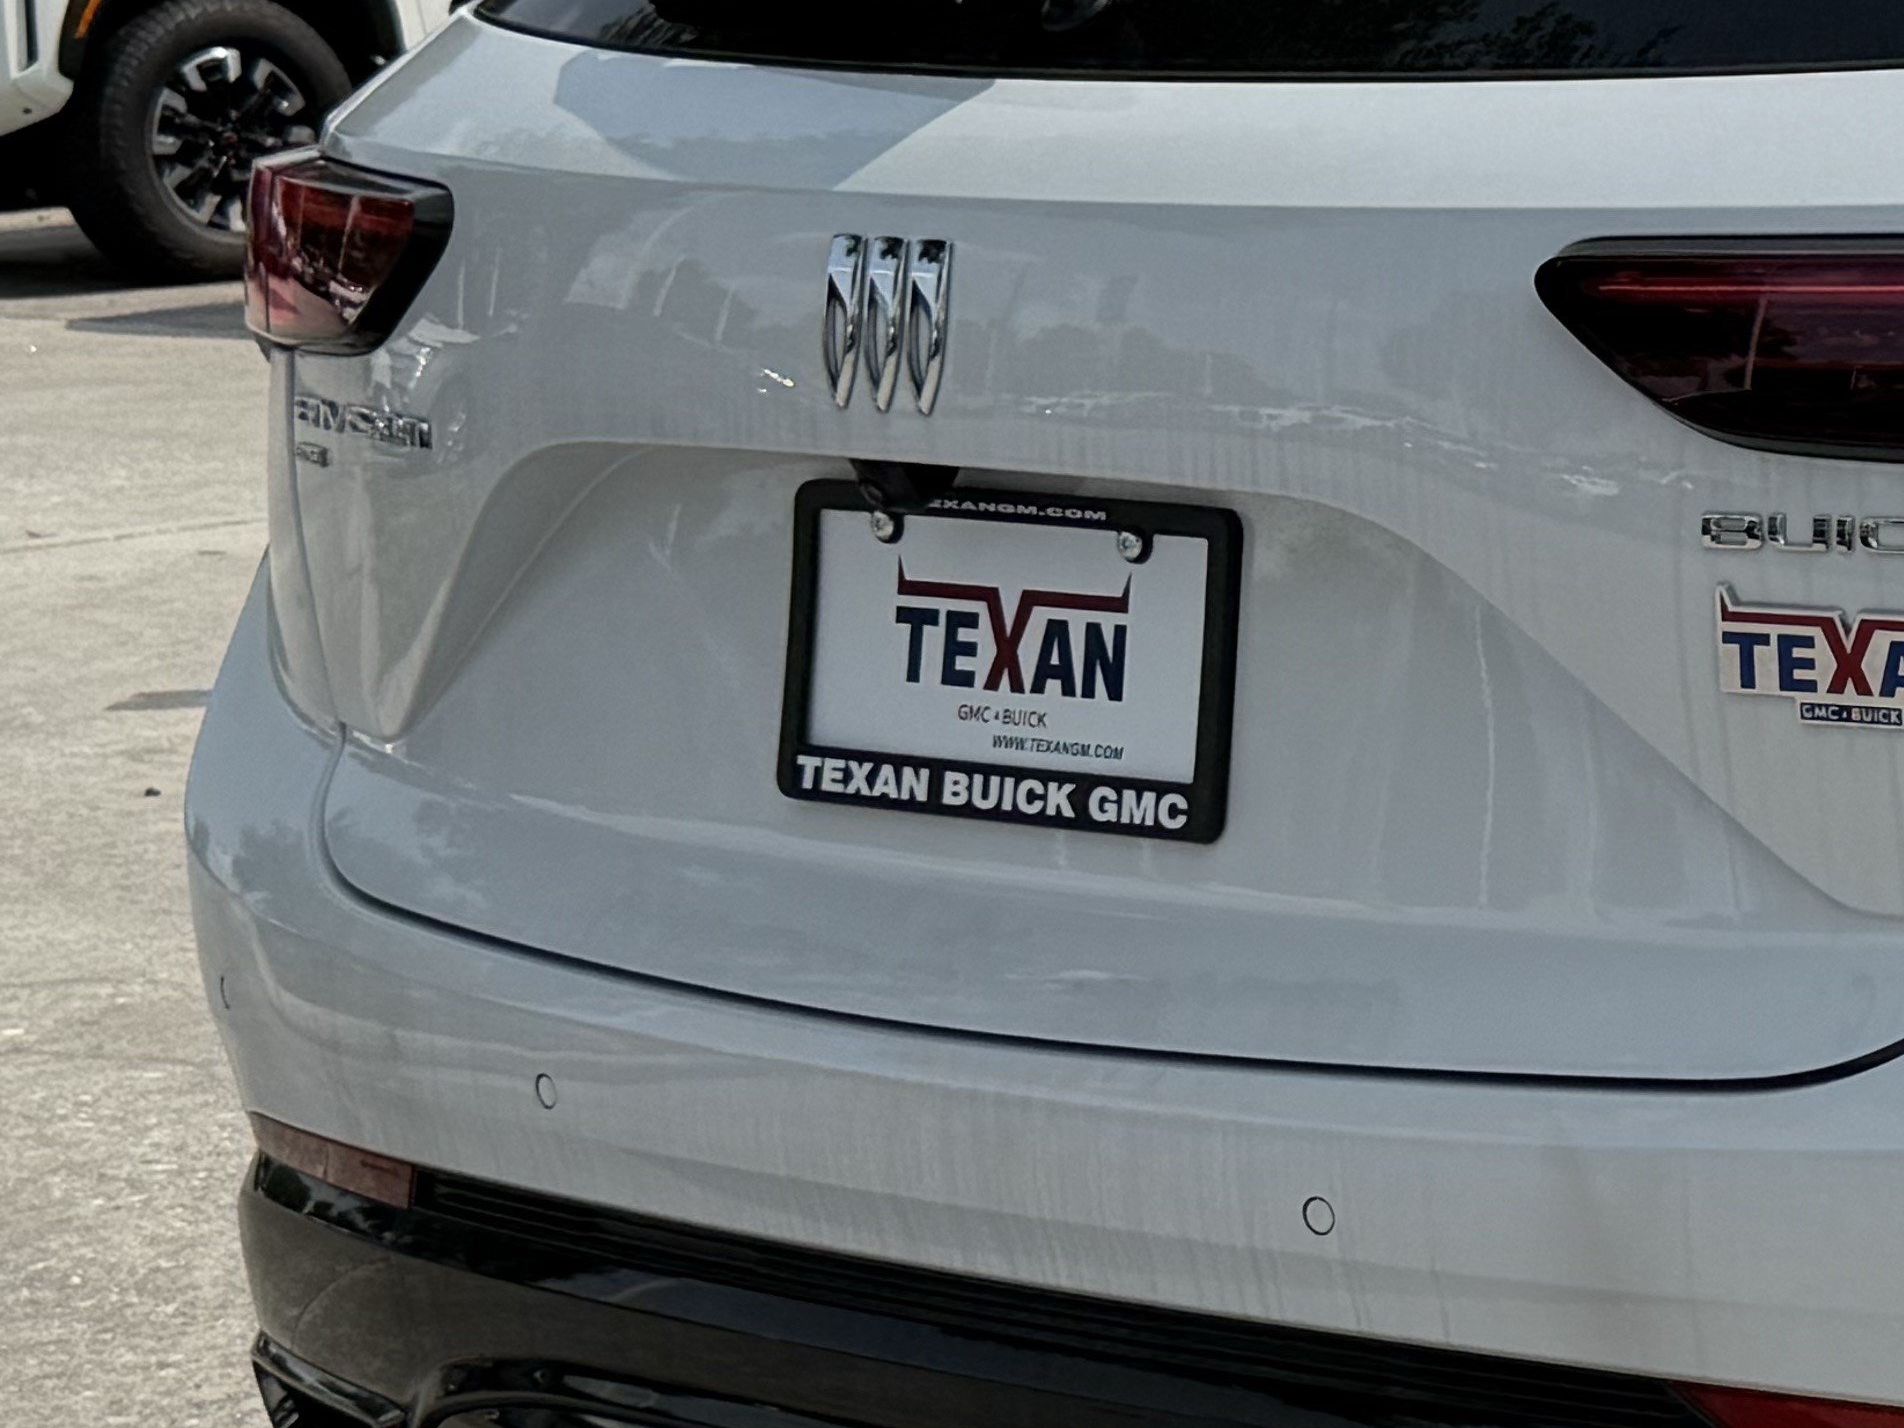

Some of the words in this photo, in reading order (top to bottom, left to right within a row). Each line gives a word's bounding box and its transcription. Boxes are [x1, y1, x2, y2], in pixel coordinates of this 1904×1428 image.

[895, 580, 1131, 702] TEXAN
[958, 704, 991, 723] GMC
[1002, 708, 1048, 728] BUICK
[1802, 704, 1840, 720] GMC
[1851, 707, 1902, 724] BUICK
[796, 755, 930, 802] TEXAN
[942, 770, 1077, 819] BUICK
[1087, 787, 1189, 830] GMC
